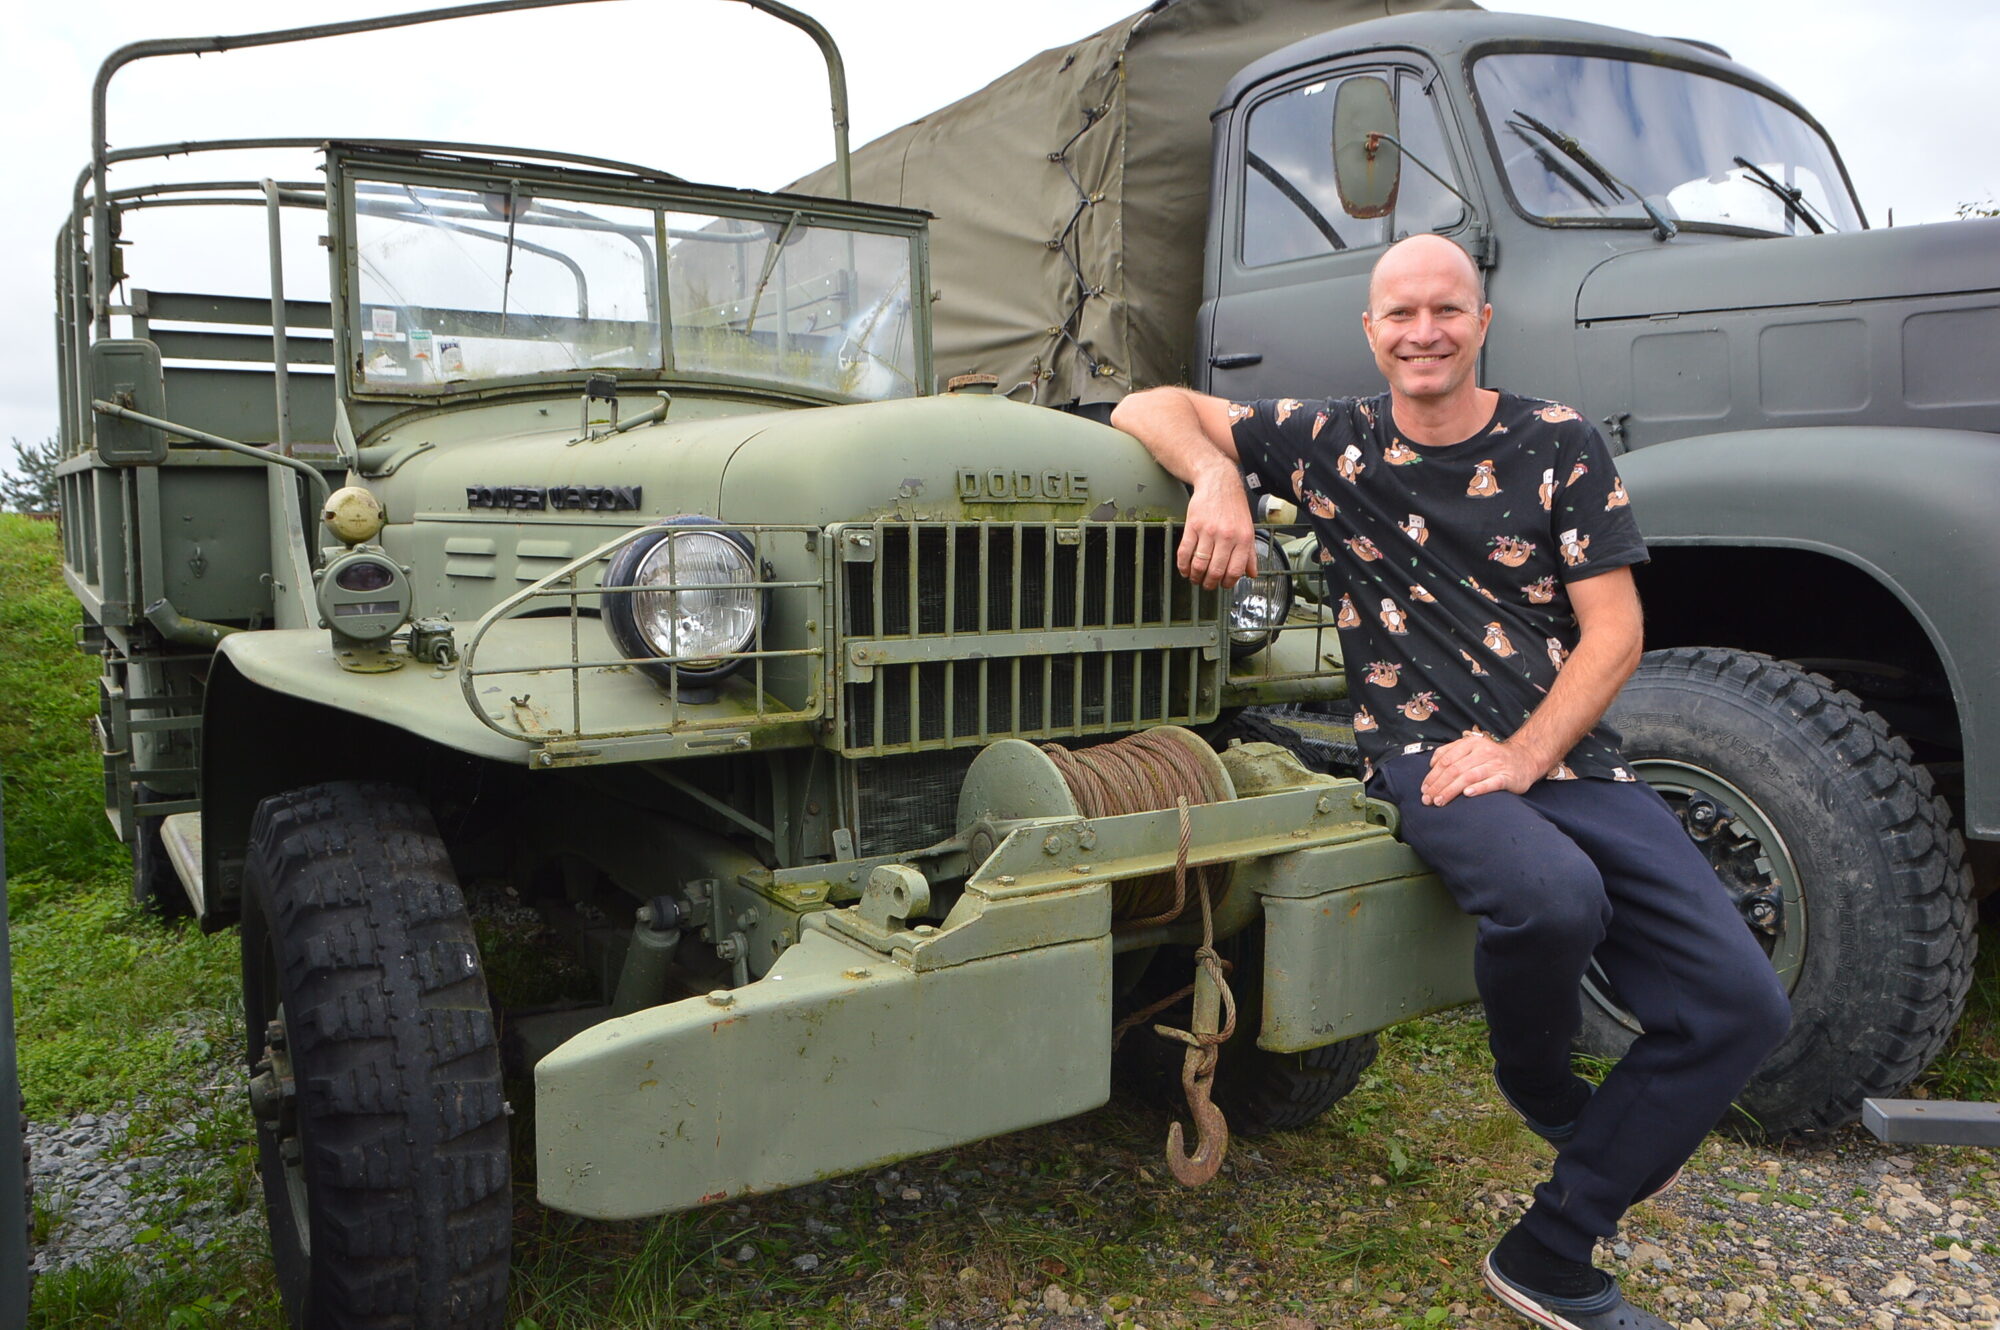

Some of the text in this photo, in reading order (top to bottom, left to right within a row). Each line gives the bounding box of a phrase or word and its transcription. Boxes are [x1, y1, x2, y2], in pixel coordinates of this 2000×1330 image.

[466, 484, 642, 510] POWER WAGON
[957, 468, 1089, 500] DODGE
